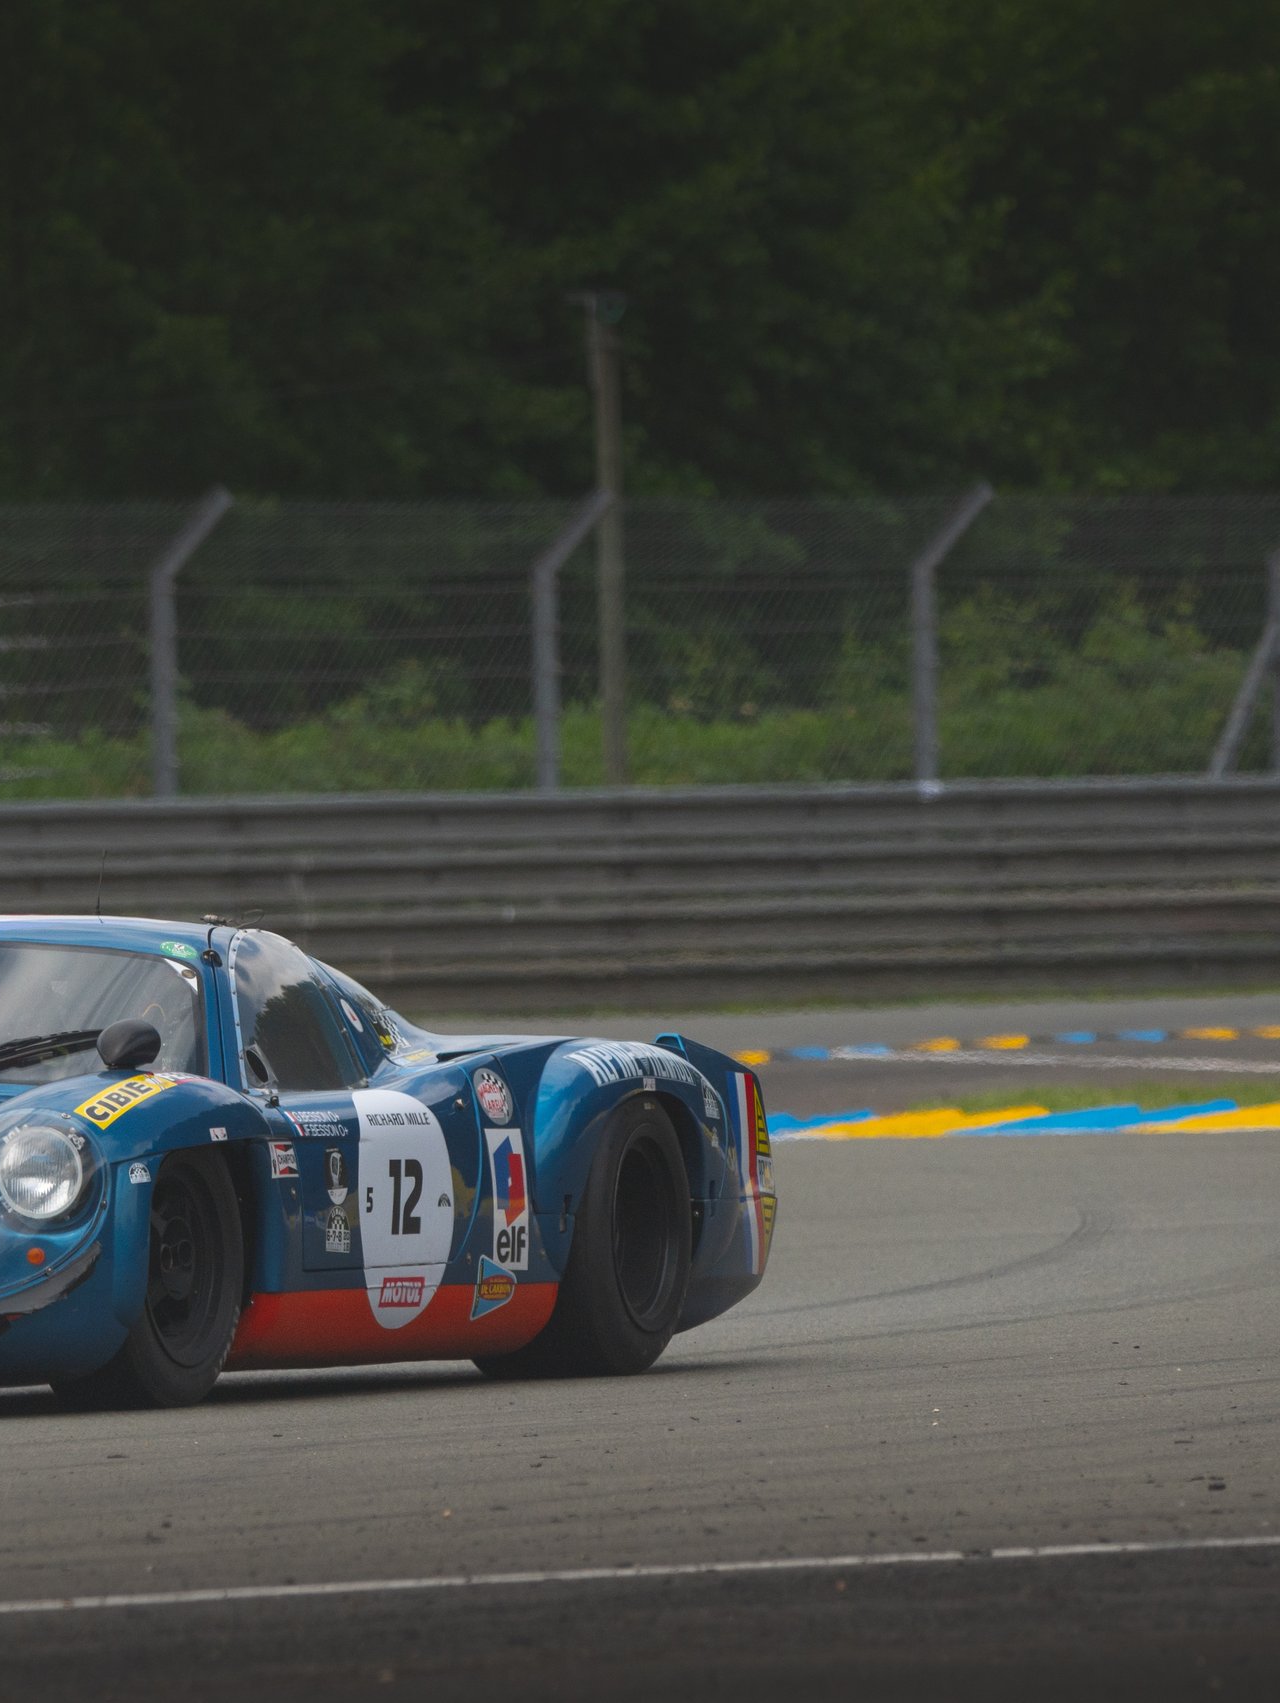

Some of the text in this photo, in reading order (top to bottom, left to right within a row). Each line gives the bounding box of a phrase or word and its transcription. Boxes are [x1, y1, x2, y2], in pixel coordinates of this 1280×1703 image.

[366, 1112, 431, 1127] RICHARD MILLE
[366, 1187, 374, 1213] 5
[389, 1158, 424, 1236] 12
[496, 1225, 526, 1264] elf
[381, 1283, 424, 1304] MOTUL
